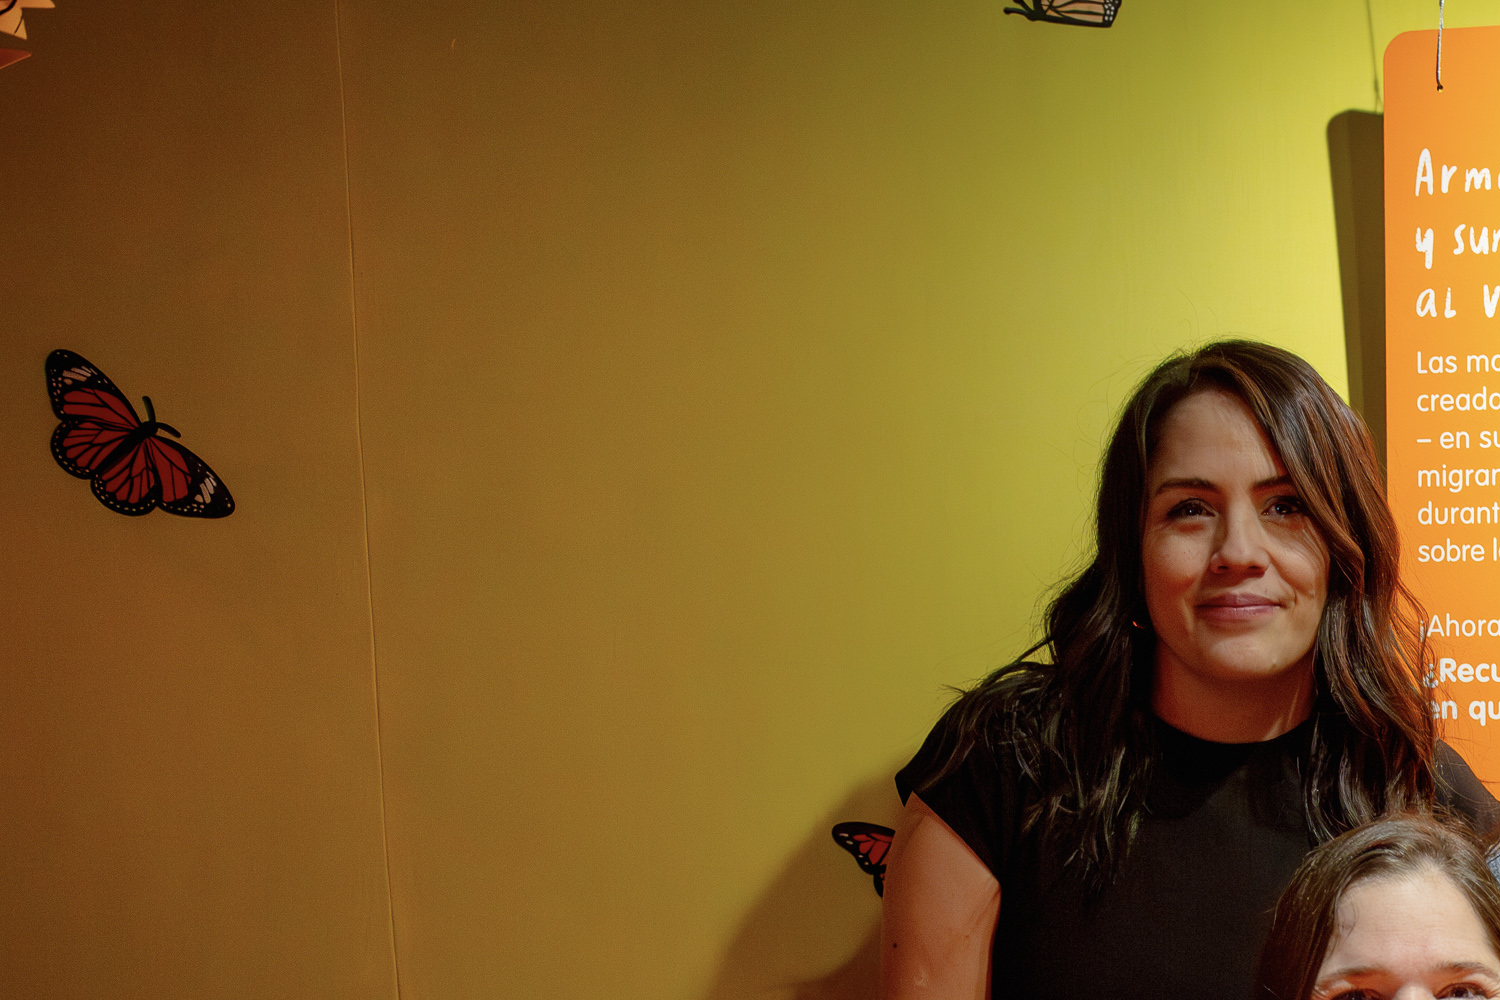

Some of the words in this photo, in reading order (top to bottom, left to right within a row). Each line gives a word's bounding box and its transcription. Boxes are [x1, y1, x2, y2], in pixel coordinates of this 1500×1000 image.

[1416, 228, 1433, 269] y
[1418, 351, 1457, 373] Las
[1440, 431, 1469, 449] en
[1418, 538, 1484, 562] sobre
